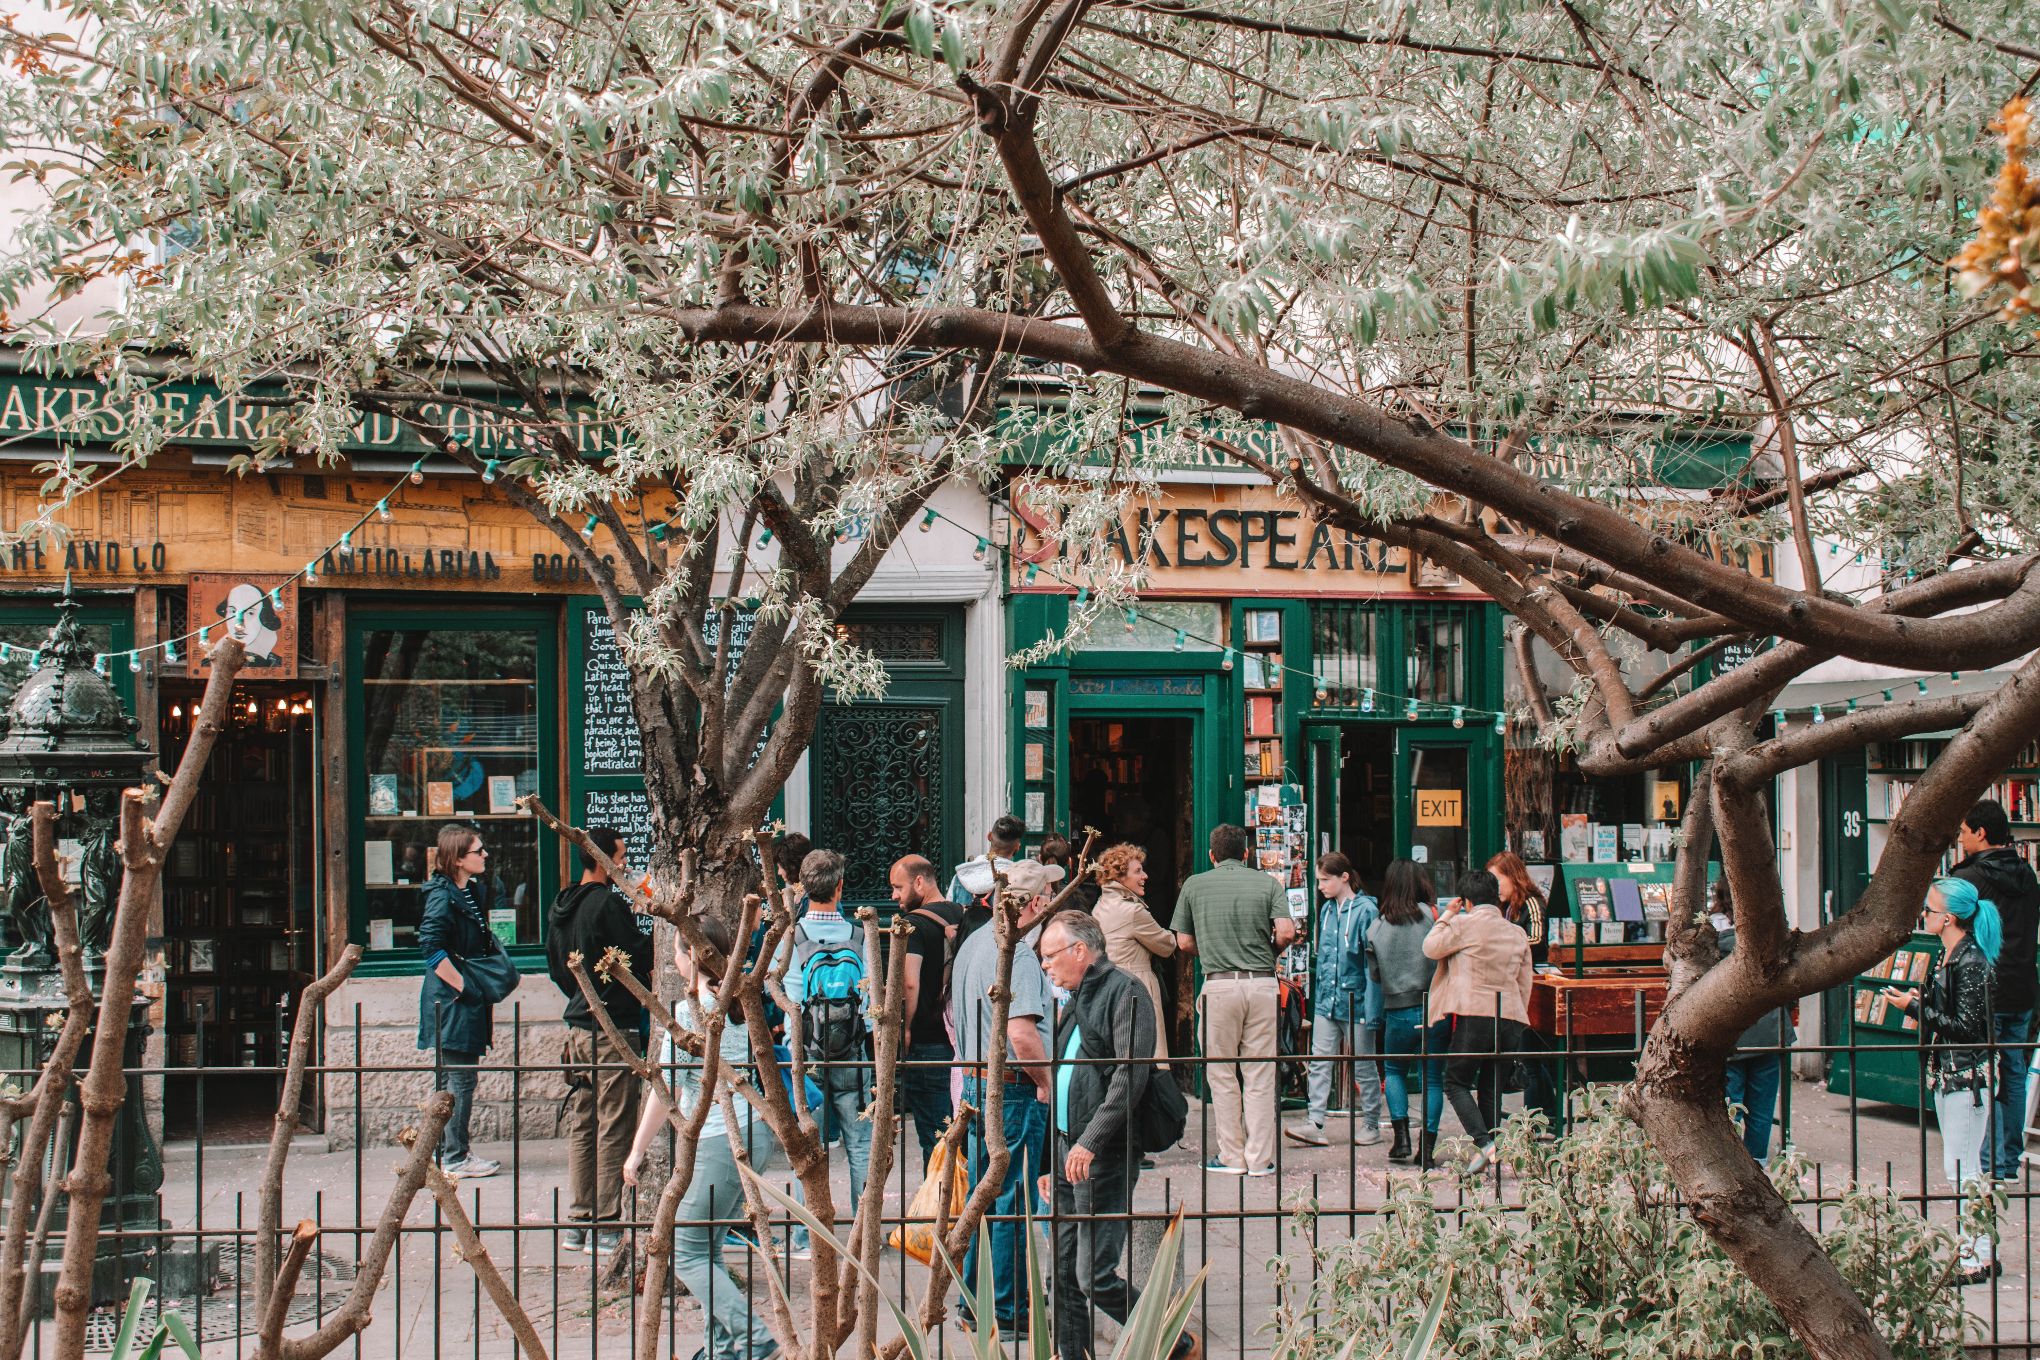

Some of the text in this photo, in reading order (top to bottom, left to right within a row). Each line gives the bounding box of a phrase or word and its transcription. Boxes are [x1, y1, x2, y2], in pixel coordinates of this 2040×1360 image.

[64, 540, 120, 573] AND
[533, 553, 616, 582] BOOS
[587, 610, 611, 625] Paris
[585, 671, 609, 682] Latin
[584, 684, 599, 696] my
[601, 681, 624, 692] head
[589, 695, 601, 706] up
[604, 693, 613, 703] in
[584, 702, 604, 715] that
[613, 705, 628, 713] can
[585, 714, 596, 729] of
[596, 717, 607, 725] us
[608, 716, 623, 725] are
[584, 736, 595, 749] of
[595, 737, 618, 750] being
[584, 757, 636, 773] a frustrated
[586, 791, 609, 805] This
[631, 791, 647, 802] has
[608, 803, 649, 816] chapters
[1421, 800, 1459, 817] EXIT
[587, 814, 610, 824] novel
[612, 813, 629, 824] and
[631, 813, 645, 823] the
[618, 822, 633, 833] and
[630, 834, 649, 844] real
[627, 843, 646, 853] next
[633, 853, 650, 863] and
